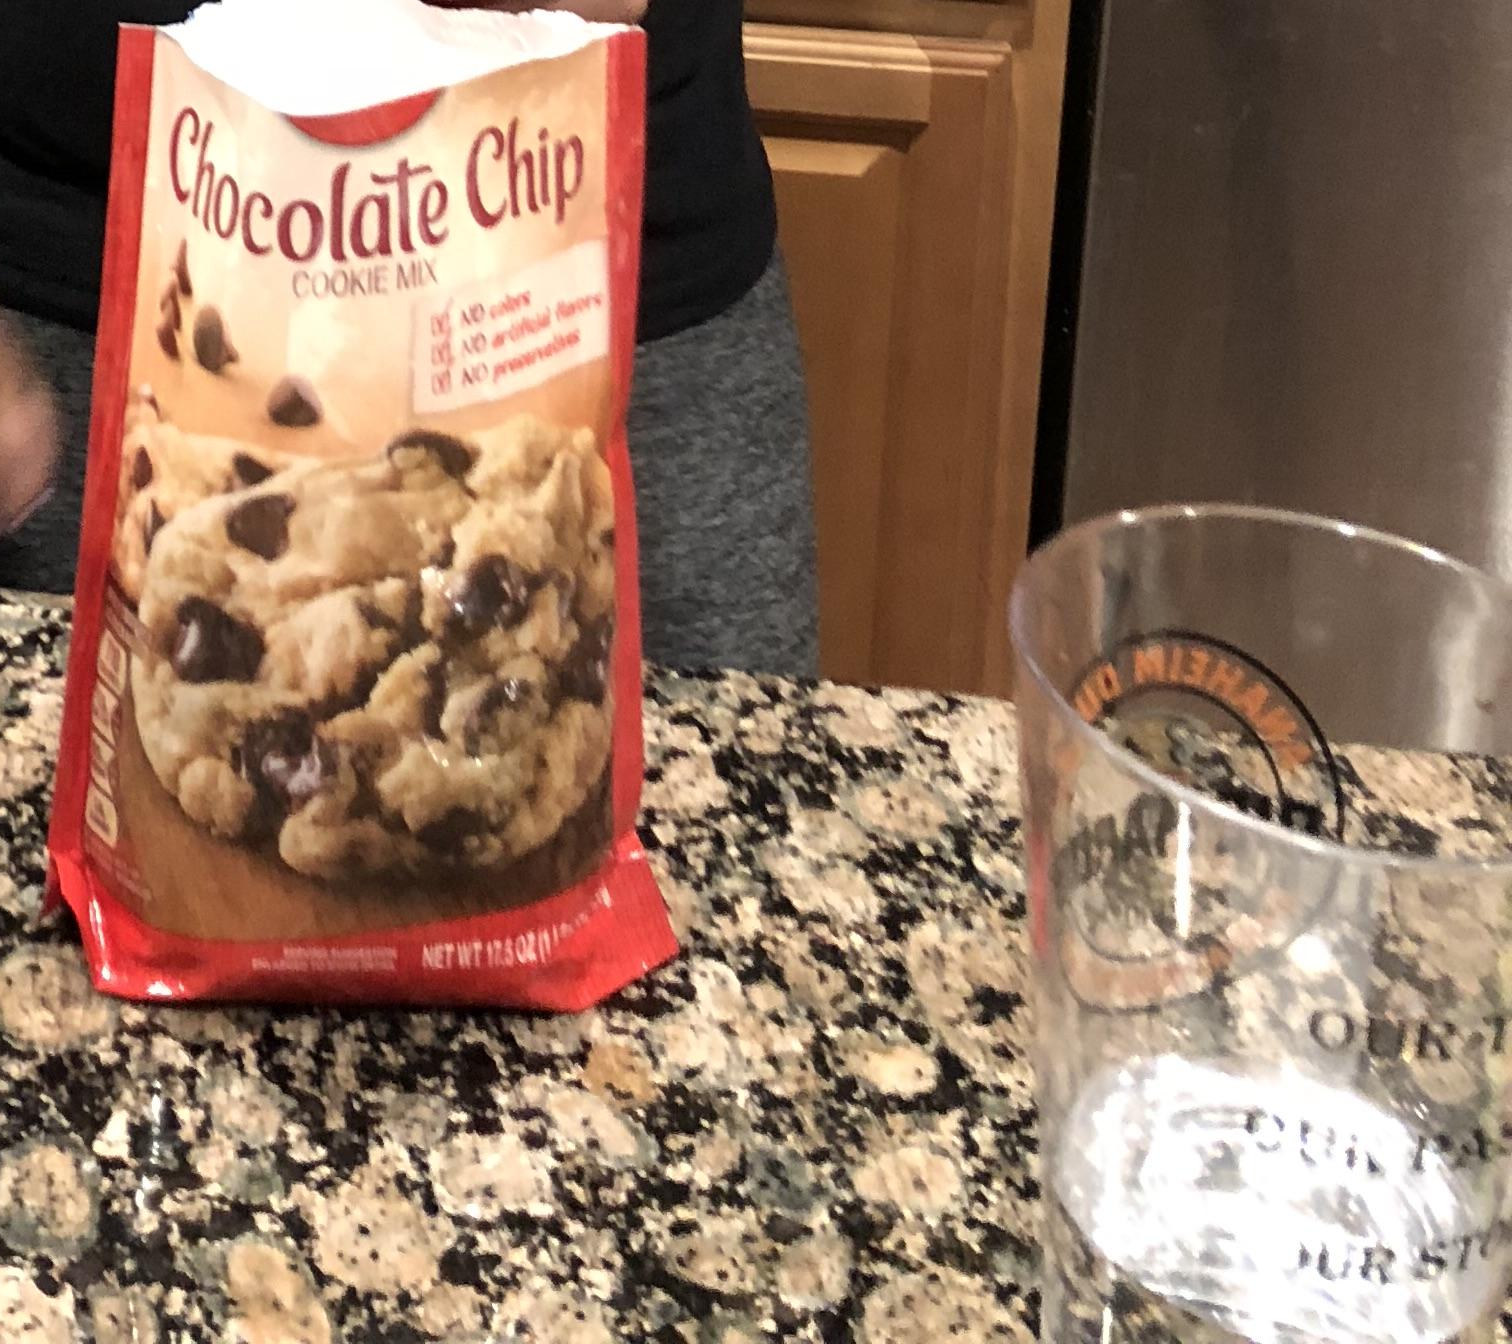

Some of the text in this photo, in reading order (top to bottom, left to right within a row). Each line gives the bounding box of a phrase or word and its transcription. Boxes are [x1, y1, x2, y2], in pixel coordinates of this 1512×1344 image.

[168, 106, 585, 263] Chocolate Chip
[291, 258, 439, 299] COOKIE MIX
[461, 303, 486, 327] NO
[462, 331, 487, 356] NO
[462, 361, 489, 386] NO
[422, 942, 455, 970] NET
[456, 938, 483, 969] WT
[1308, 1009, 1452, 1062] OUR
